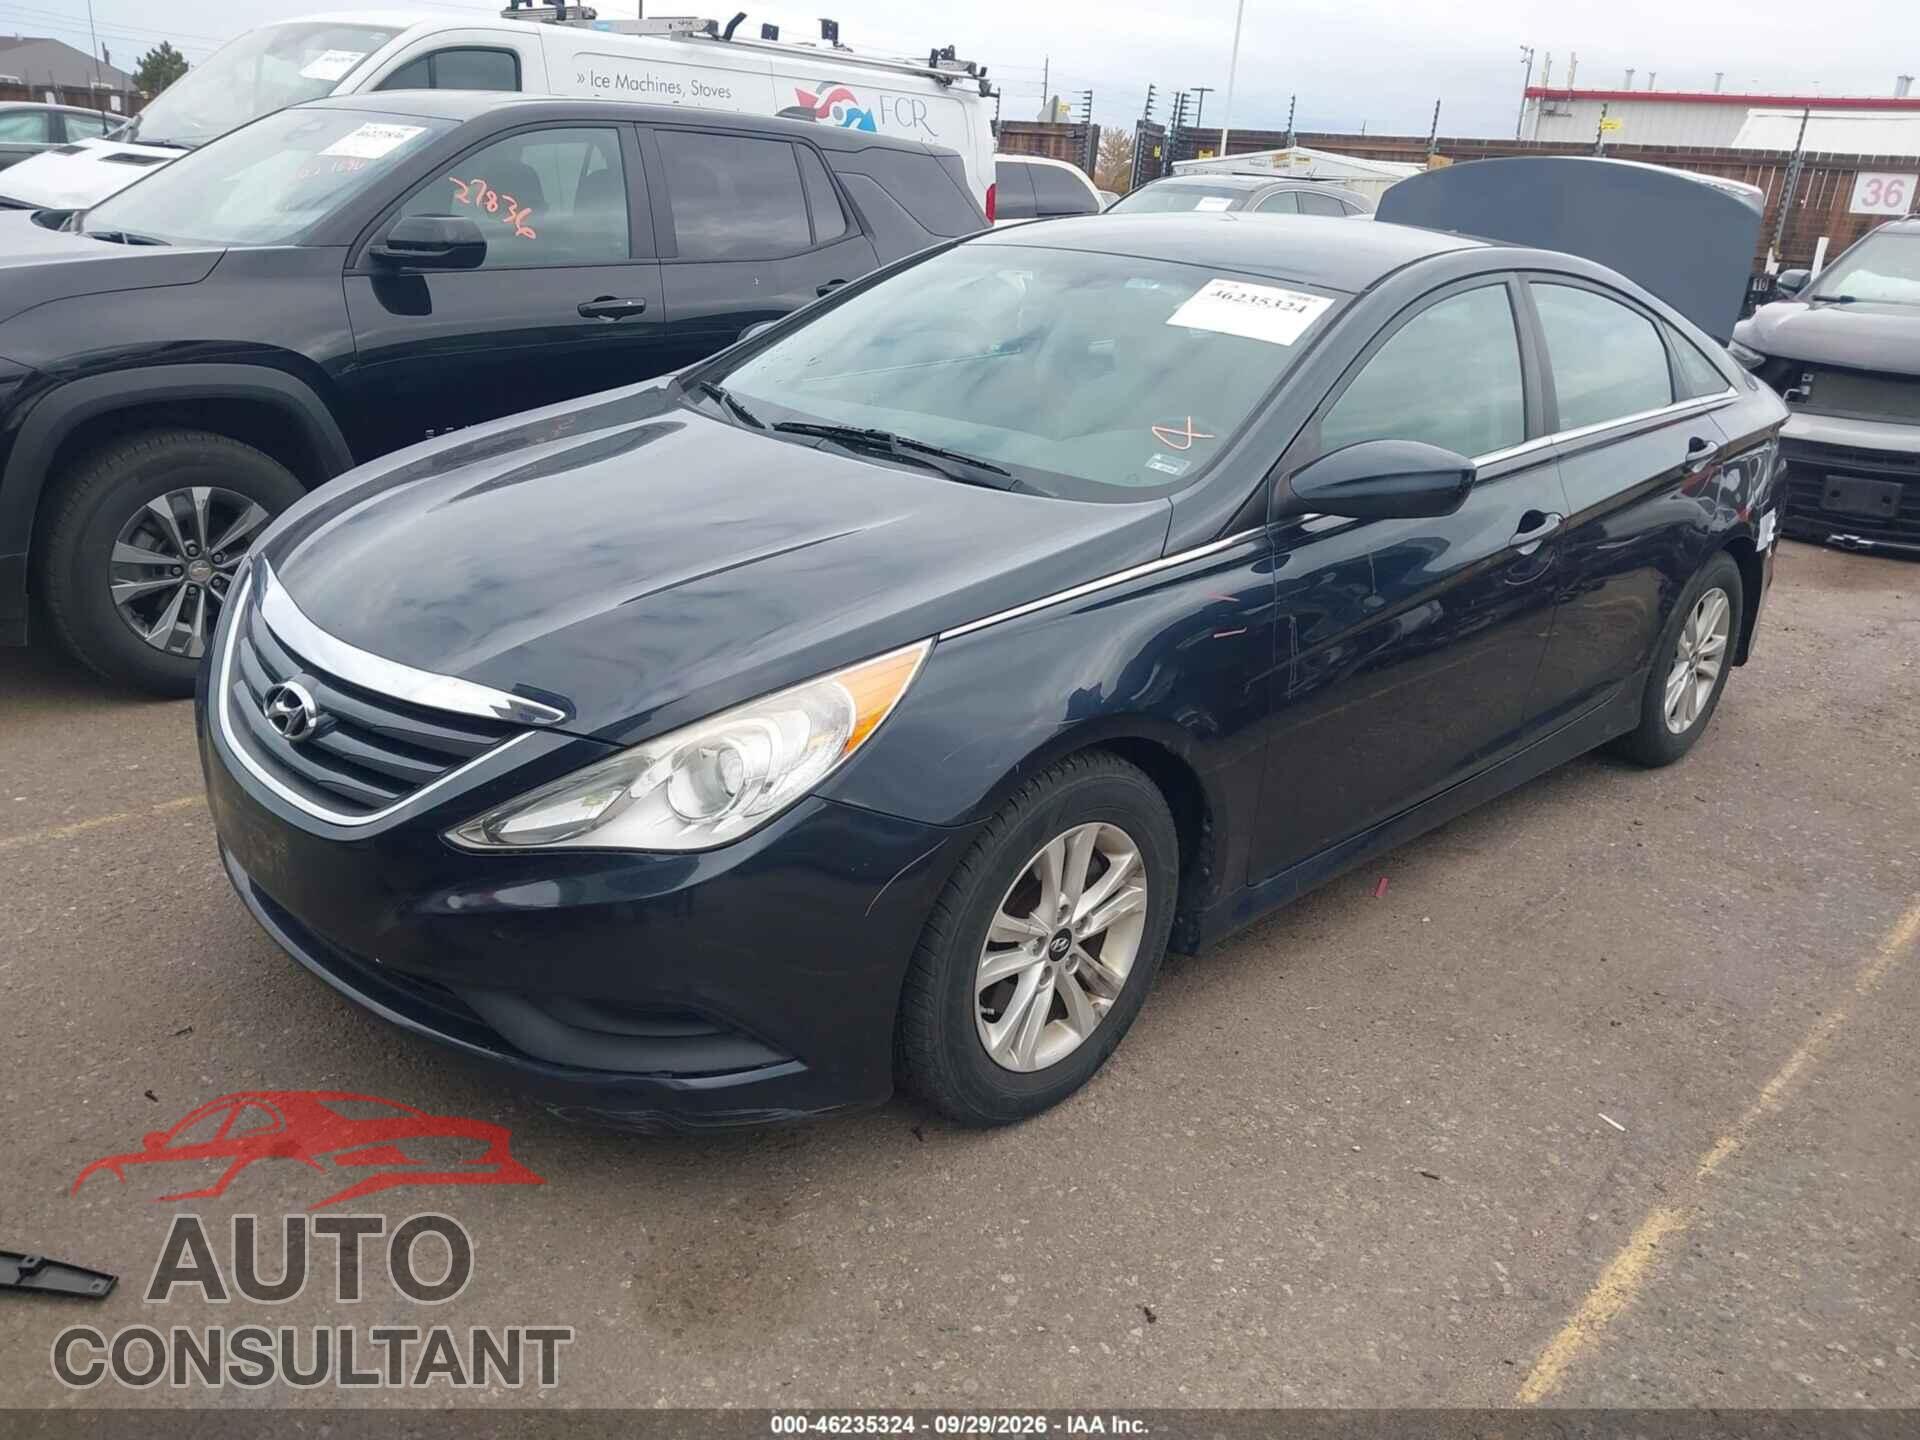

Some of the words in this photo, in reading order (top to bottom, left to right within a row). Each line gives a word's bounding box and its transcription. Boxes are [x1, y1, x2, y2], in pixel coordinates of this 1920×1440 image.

[590, 70, 610, 88] Ice
[615, 73, 686, 98] Machines,
[691, 79, 732, 98] Stoves
[880, 95, 938, 136] FCR
[449, 177, 537, 240] 27836
[1862, 178, 1905, 208] 36
